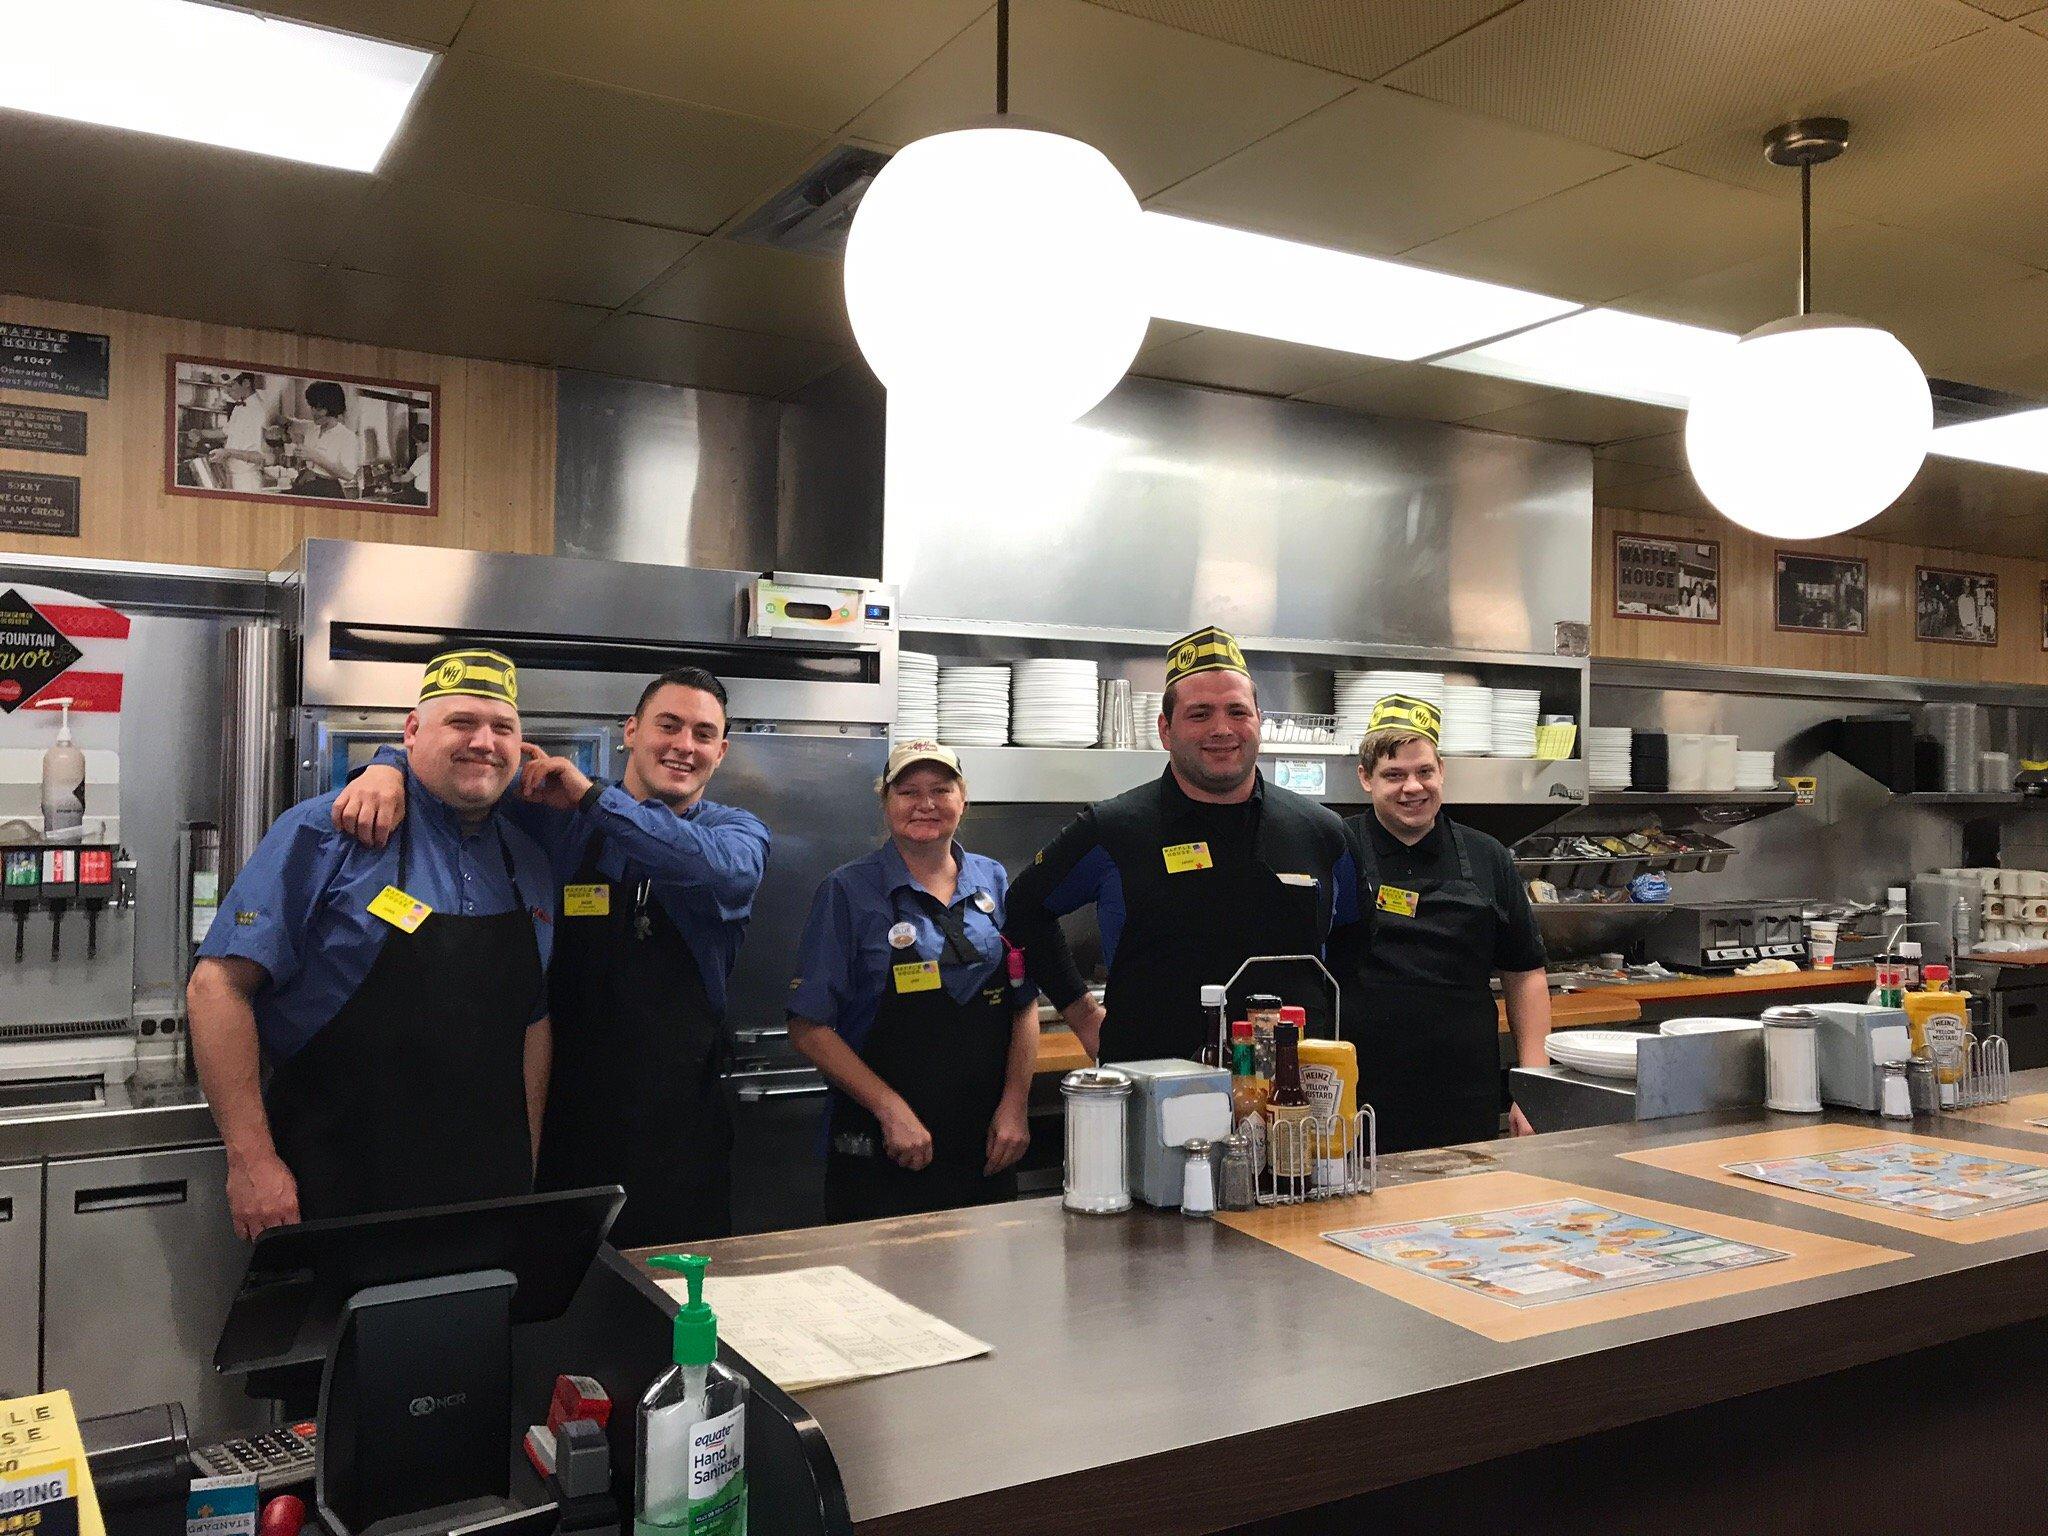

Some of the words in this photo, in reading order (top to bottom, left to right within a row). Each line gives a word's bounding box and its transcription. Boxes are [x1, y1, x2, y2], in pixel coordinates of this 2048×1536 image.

[2, 337, 64, 354] HOUSE
[13, 355, 52, 366] #1047
[0, 366, 47, 378] Operated
[8, 481, 41, 492] SORRY
[13, 494, 32, 503] CAN
[34, 496, 52, 504] NOT
[9, 506, 29, 514] ANY
[31, 507, 66, 518] CHECKS
[1620, 544, 1678, 567] WAFFLE
[1622, 566, 1676, 589] HOUSE
[1180, 649, 1194, 665] WH
[442, 665, 461, 683] WH
[1415, 710, 1429, 726] WH
[1935, 1019, 1955, 1027] HEINZ
[1305, 1072, 1329, 1081] HEINZ
[694, 1424, 734, 1447] equate
[694, 1445, 726, 1469] Hand
[694, 1454, 741, 1485] Sanitizer
